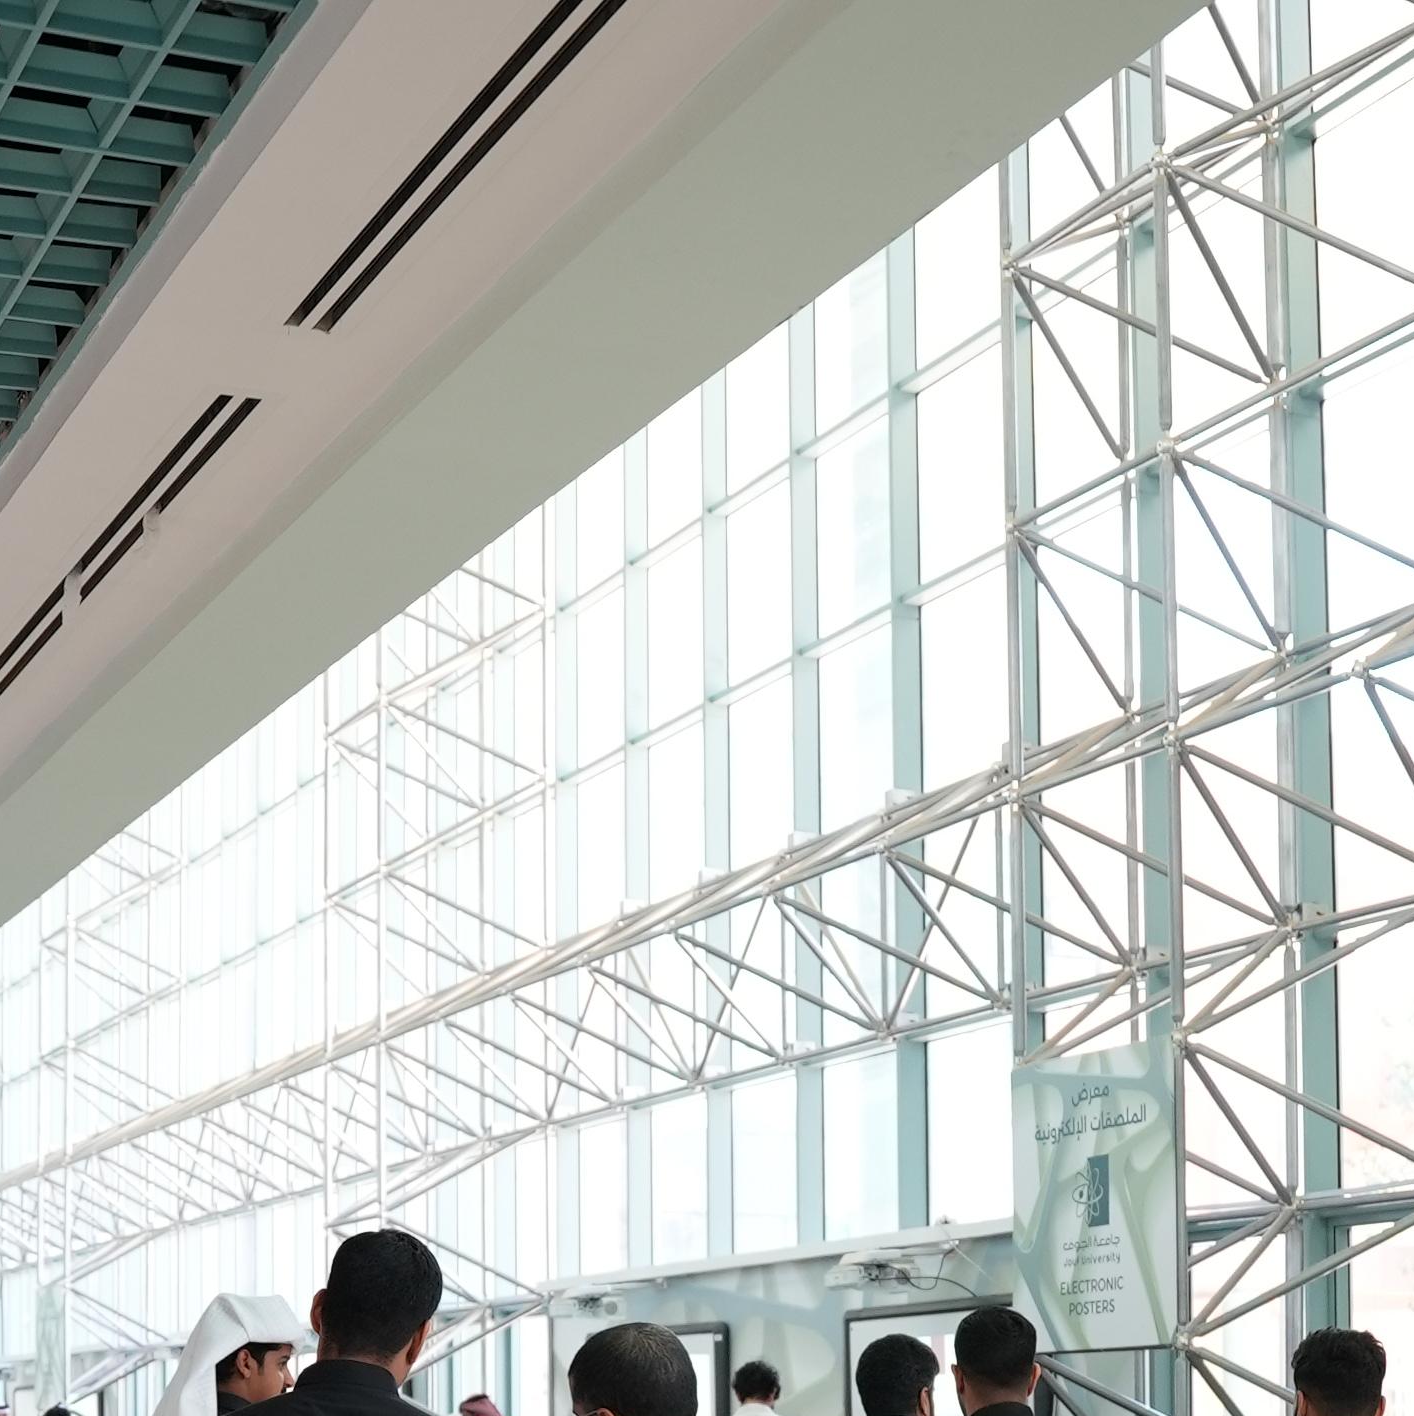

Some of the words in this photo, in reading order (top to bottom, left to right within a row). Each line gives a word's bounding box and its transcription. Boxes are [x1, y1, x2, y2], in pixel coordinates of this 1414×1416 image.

[1071, 1082, 1110, 1107] معرض
[1035, 1115, 1087, 1144] الإلكترونية
[1091, 1103, 1146, 1131] الملصقات
[1060, 1276, 1123, 1295] ELECTRONIC
[1069, 1299, 1116, 1316] POSTERS
